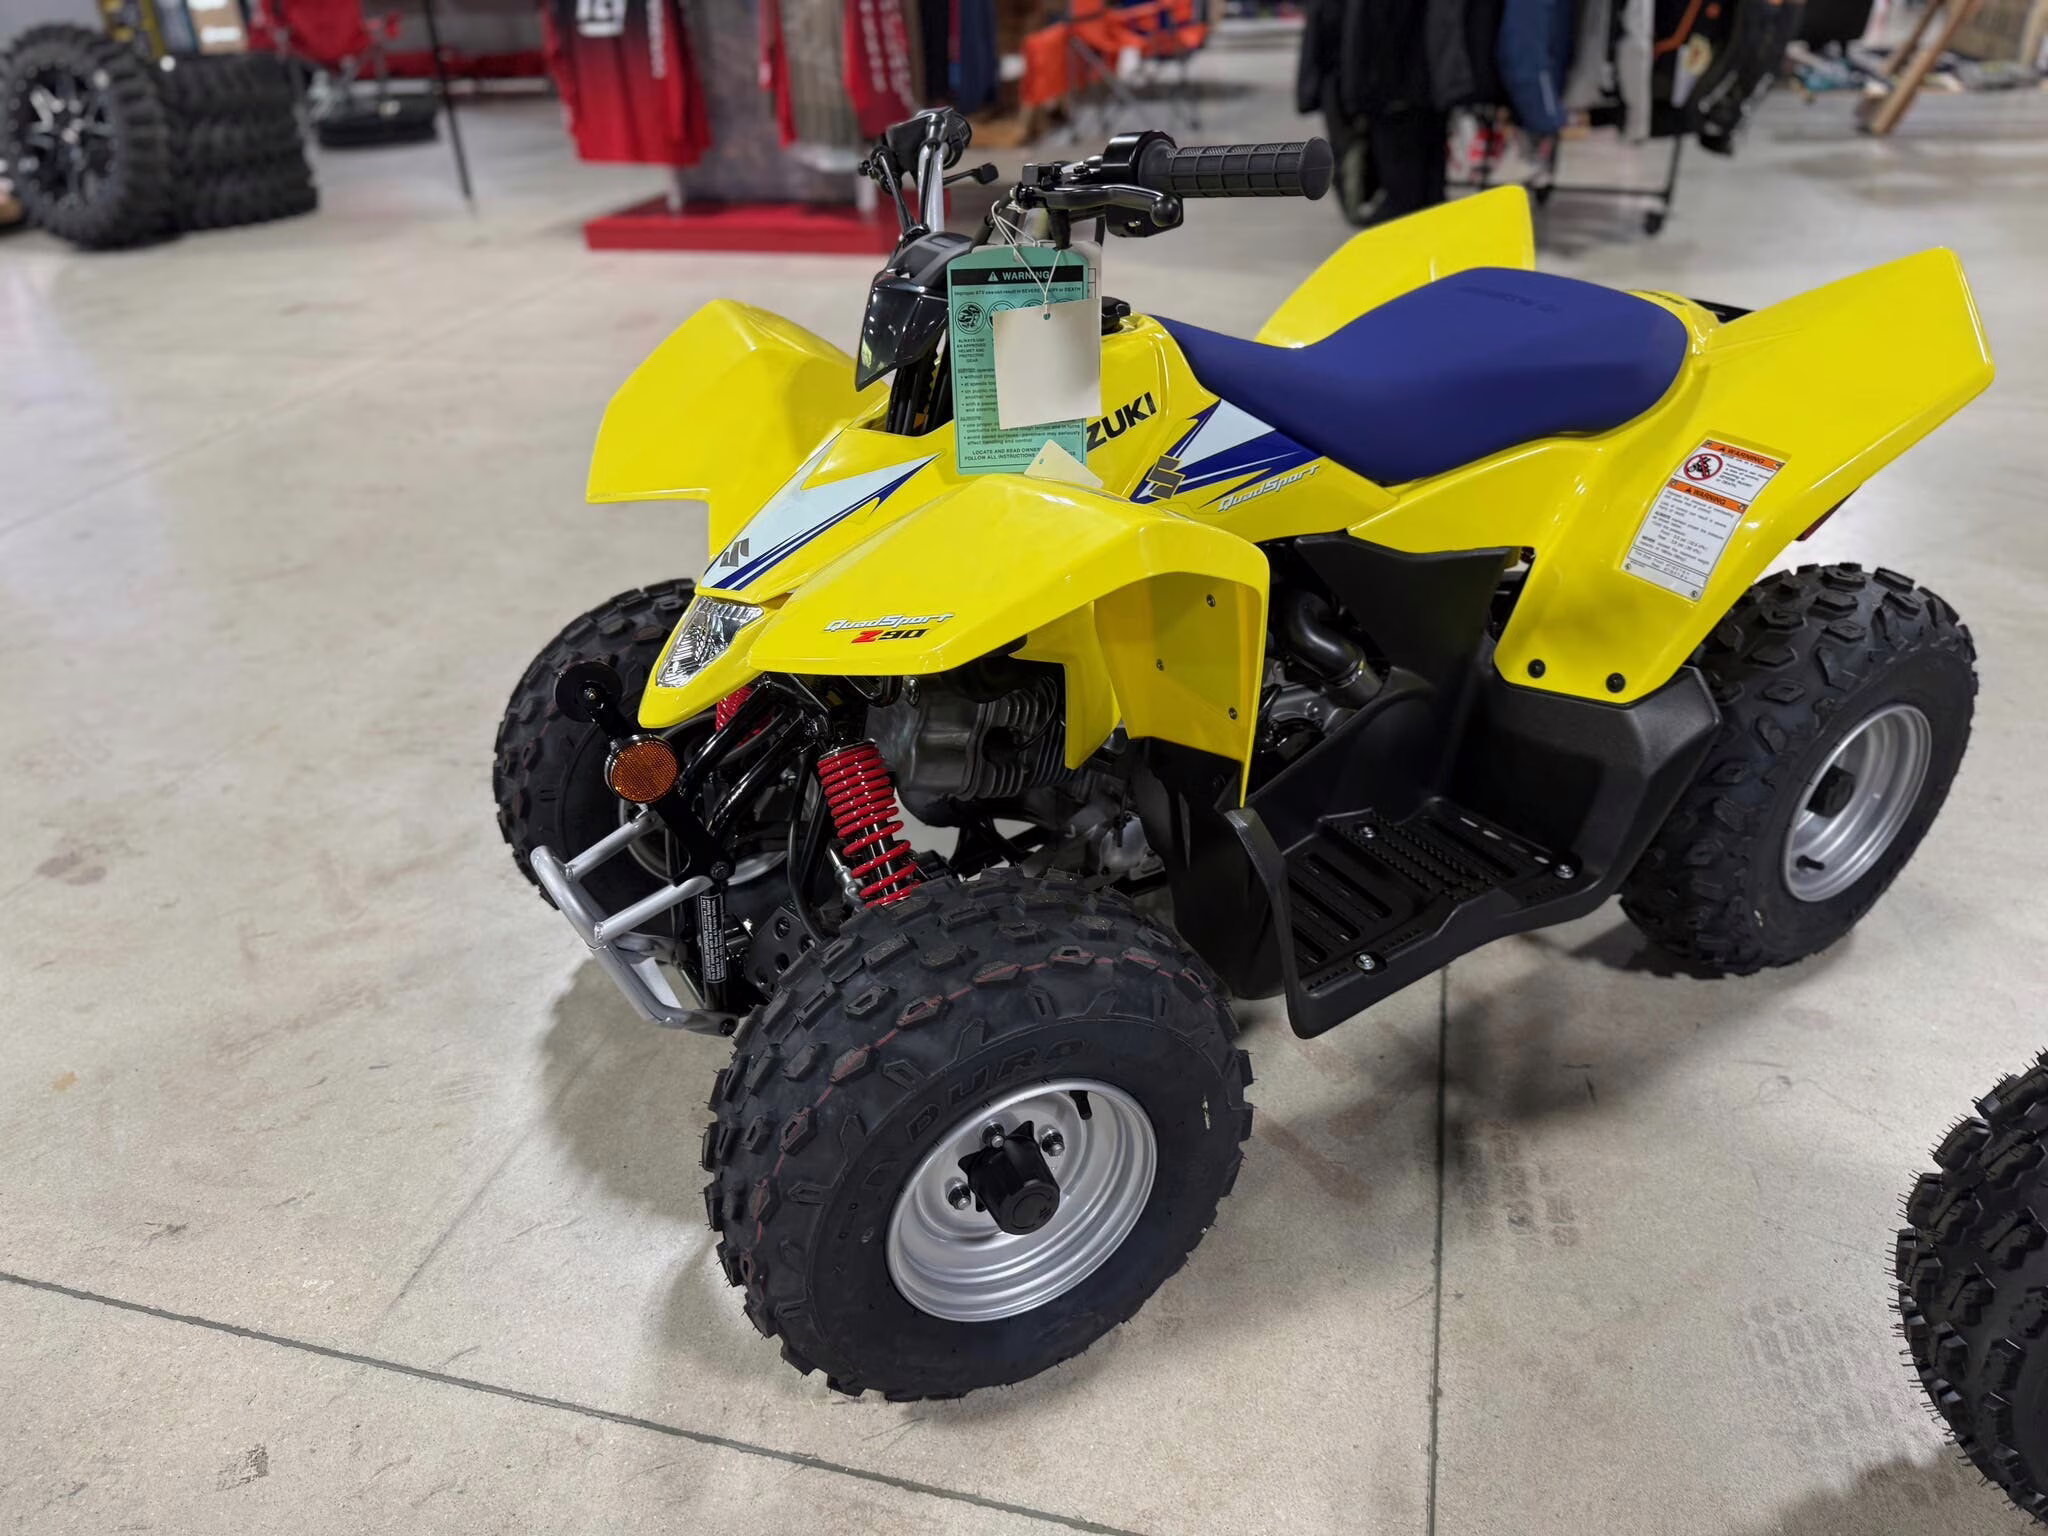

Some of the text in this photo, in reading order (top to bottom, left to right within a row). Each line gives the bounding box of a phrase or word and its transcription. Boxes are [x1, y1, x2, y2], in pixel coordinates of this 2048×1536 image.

[1002, 270, 1050, 281] WARNING
[1727, 447, 1765, 465] WARNING
[1218, 464, 1320, 513] QuadSport
[1694, 489, 1726, 505] WARNING
[824, 612, 954, 632] QuadSport
[851, 628, 930, 644] Z90
[905, 1039, 1087, 1143] DURO
